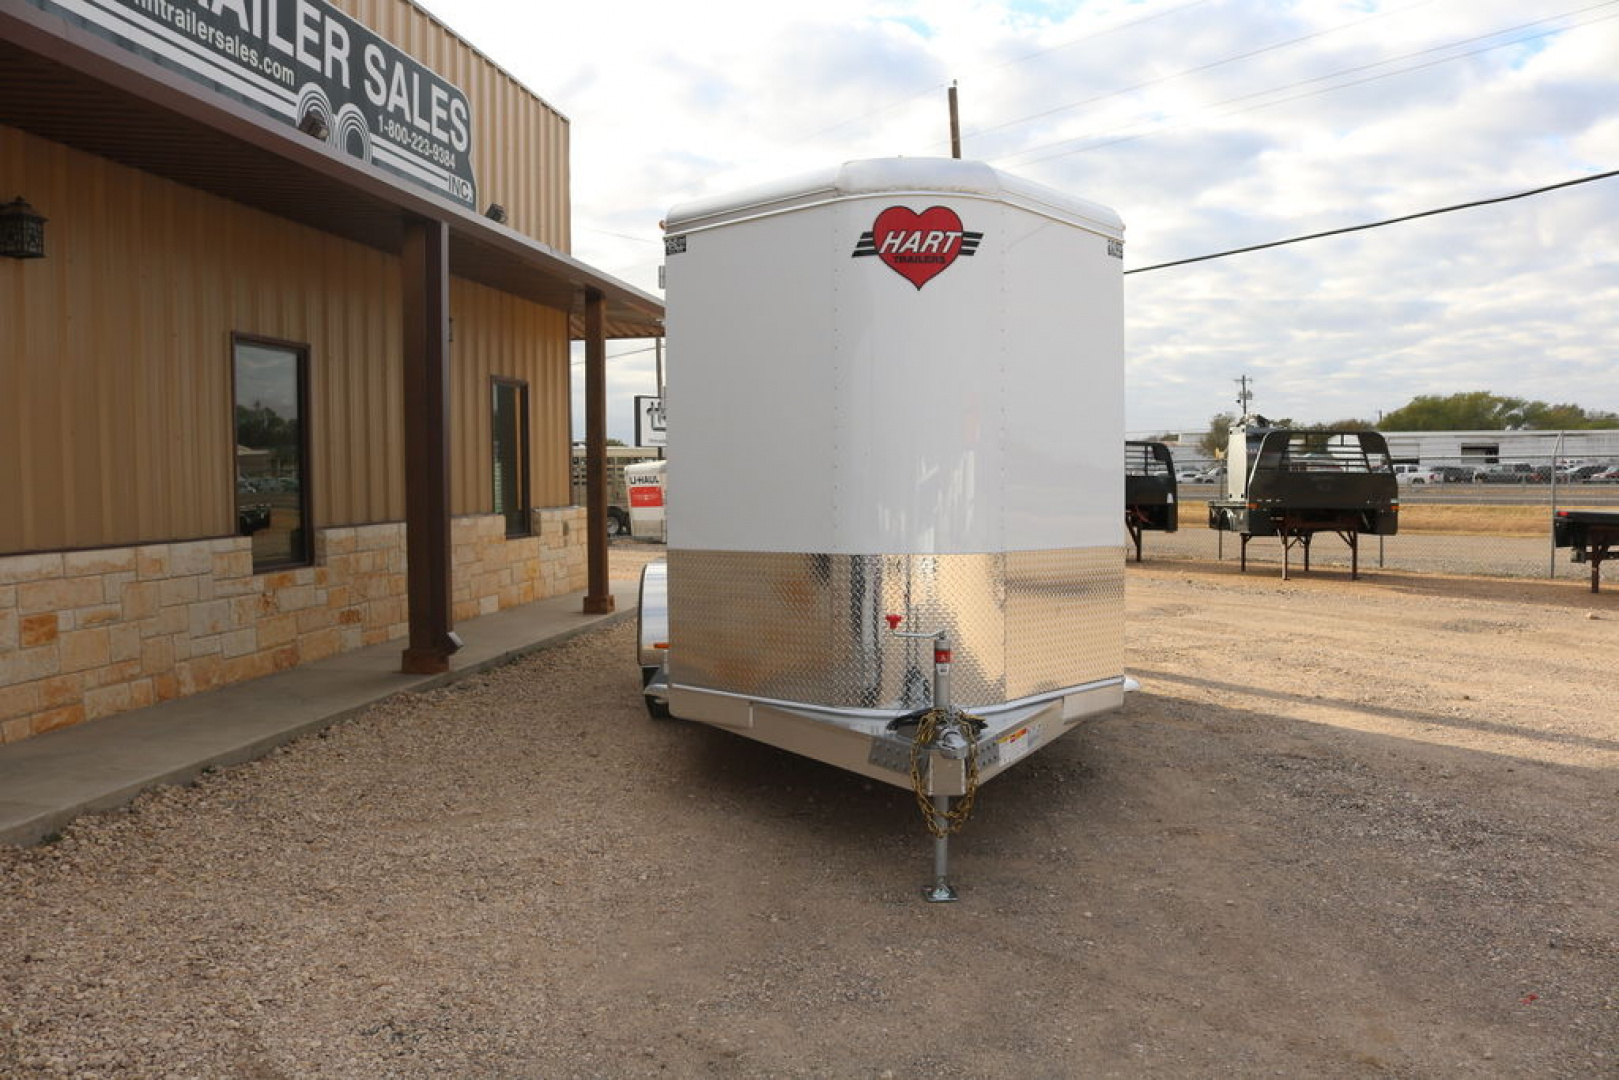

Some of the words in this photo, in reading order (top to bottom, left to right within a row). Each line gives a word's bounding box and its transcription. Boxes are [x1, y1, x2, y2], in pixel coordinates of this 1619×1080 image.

[364, 43, 468, 153] SALES
[378, 115, 455, 169] 1-800-223-9384
[879, 230, 963, 254] HART
